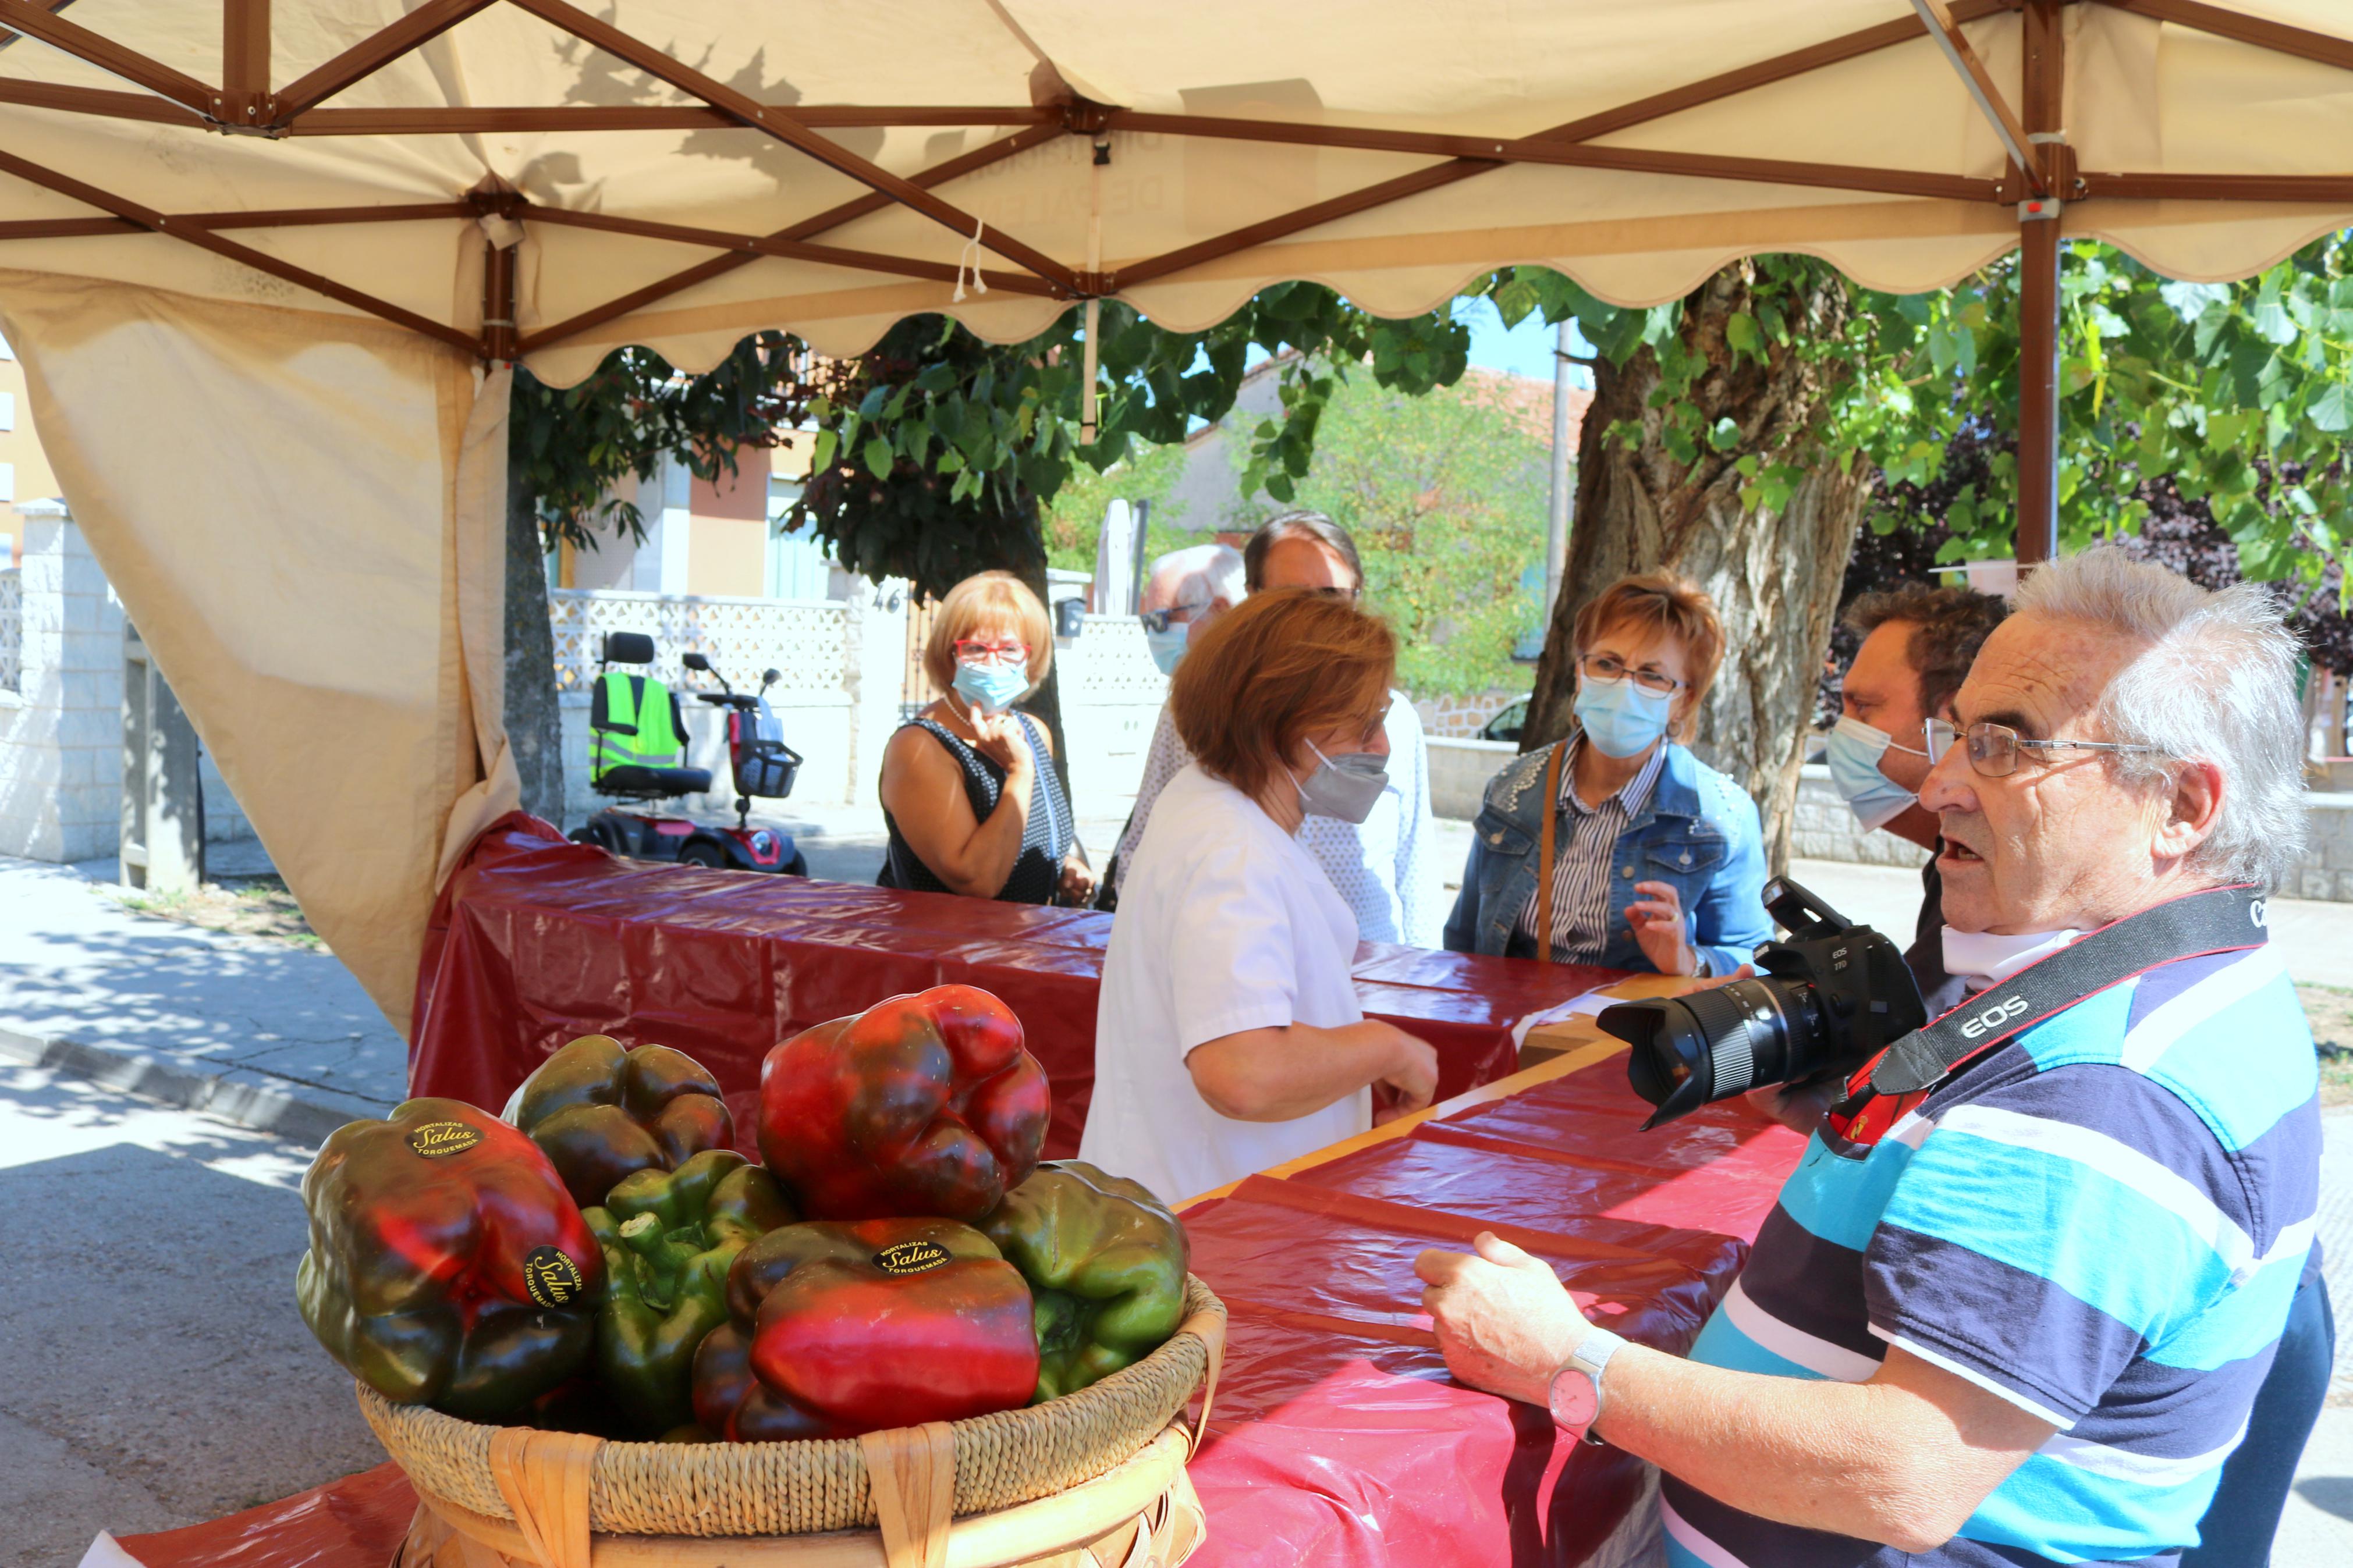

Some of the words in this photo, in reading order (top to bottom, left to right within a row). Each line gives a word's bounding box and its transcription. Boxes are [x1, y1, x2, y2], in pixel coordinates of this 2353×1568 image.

[1833, 947, 1848, 959] EOS
[1834, 960, 1847, 970] 77D
[1961, 994, 2028, 1039] EOS
[414, 1122, 463, 1133] HORTALIZAS
[413, 1127, 475, 1149] Salus
[417, 1139, 478, 1155] TORQUEMADA
[880, 1242, 928, 1257] HORTALIZAS
[882, 1247, 942, 1268] Salus
[555, 1251, 582, 1291] HORTALIZAS
[889, 1257, 947, 1274] TORQUEMADA
[526, 1263, 555, 1309] TORQUEMADA
[534, 1256, 572, 1303] Salus
